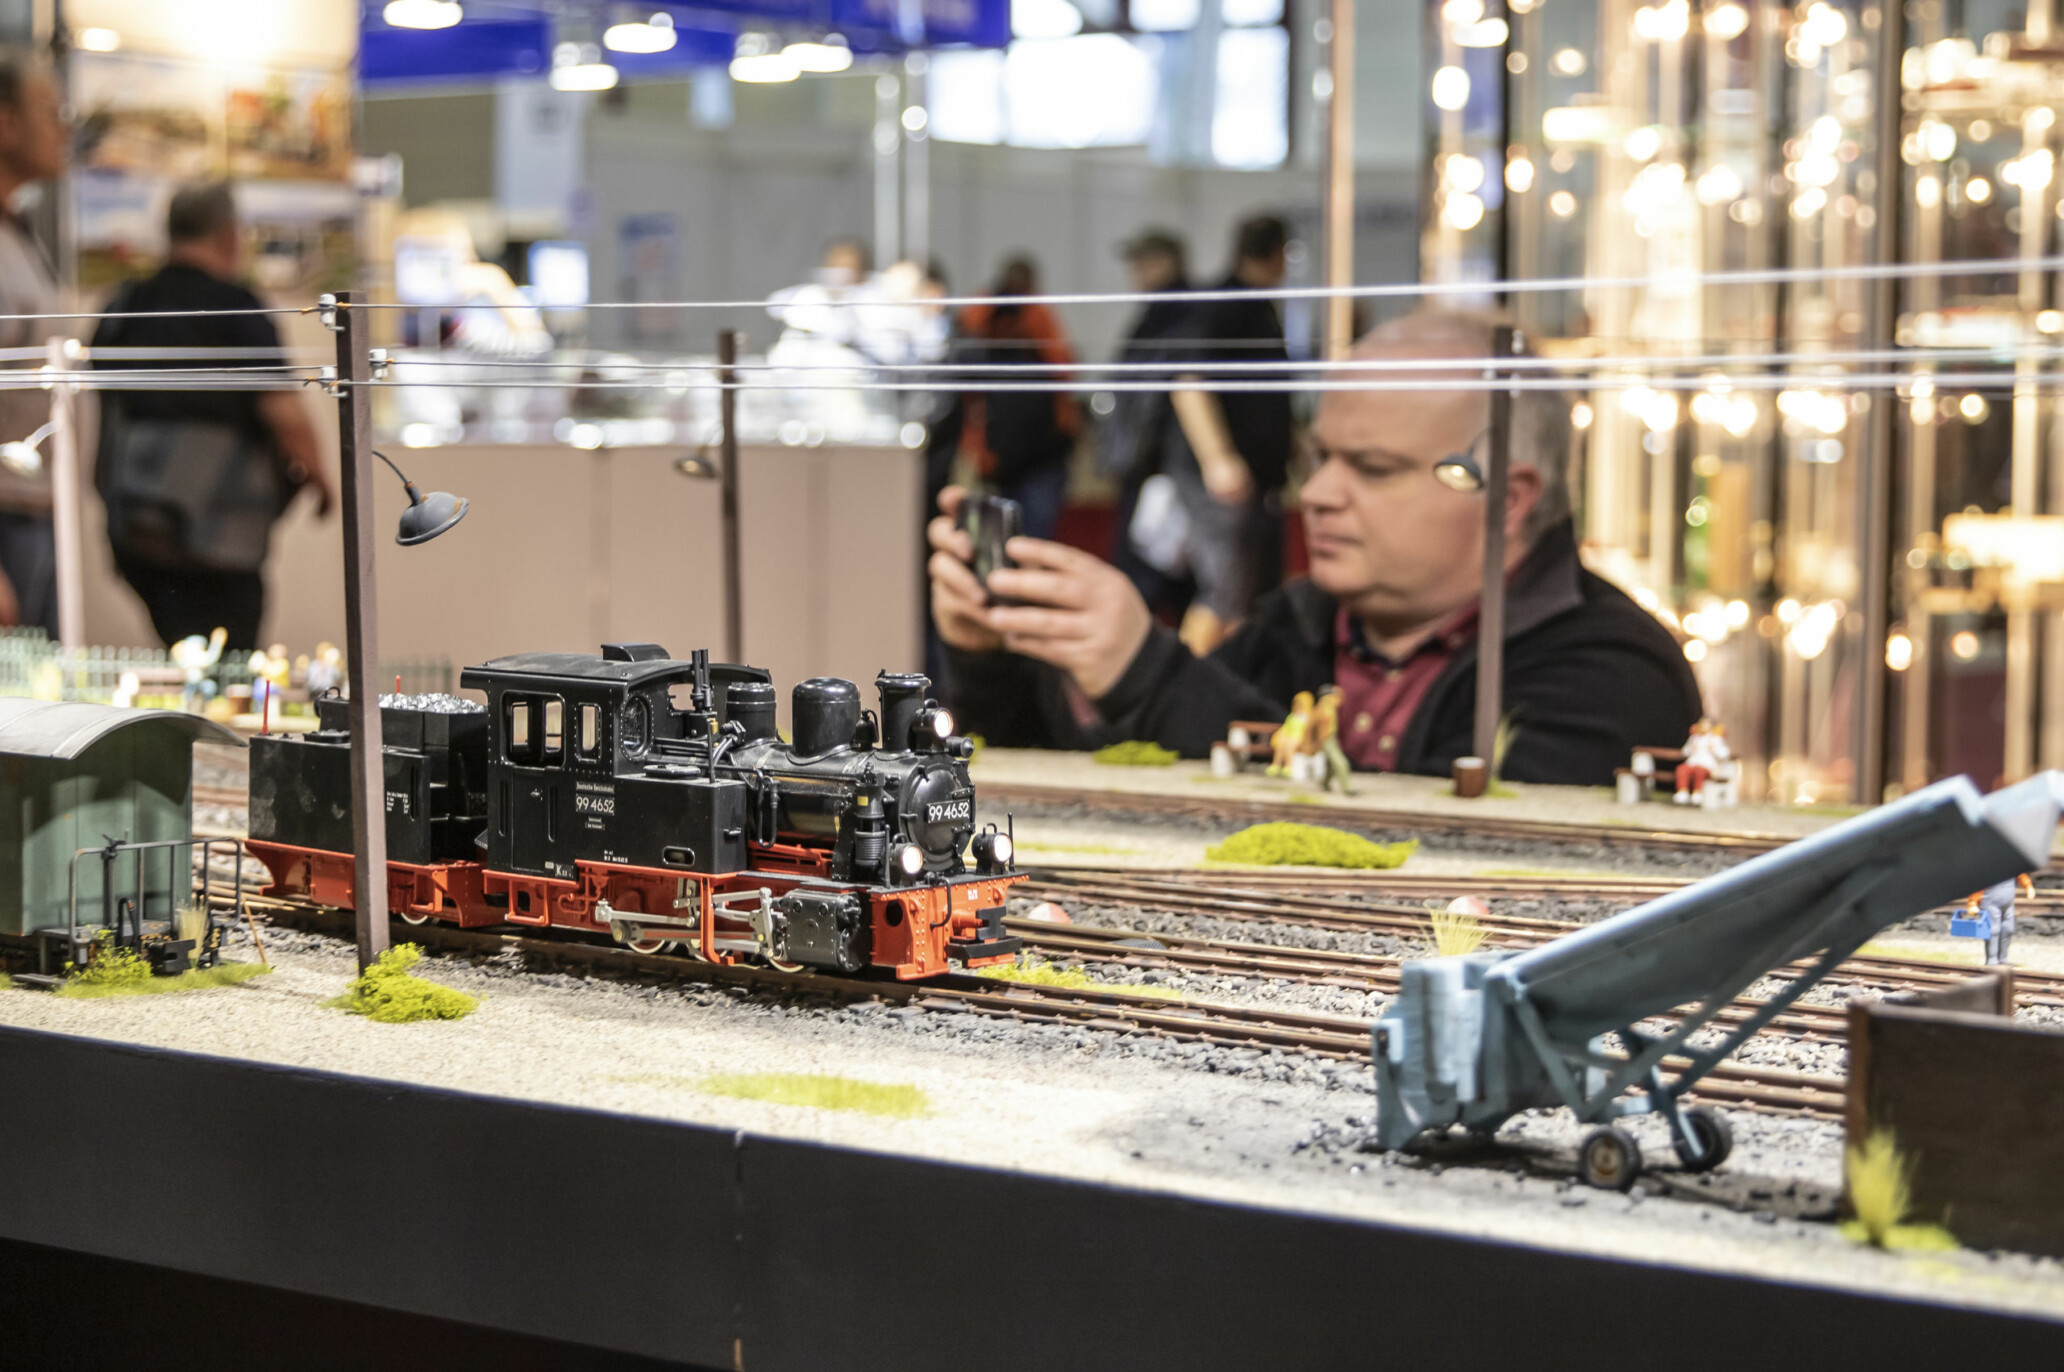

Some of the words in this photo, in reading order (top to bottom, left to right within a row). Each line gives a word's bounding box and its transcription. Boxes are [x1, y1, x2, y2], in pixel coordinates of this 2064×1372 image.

[576, 796, 589, 810] 99
[590, 799, 614, 812] 4652
[929, 806, 942, 821] 99
[943, 803, 969, 819] 4652
